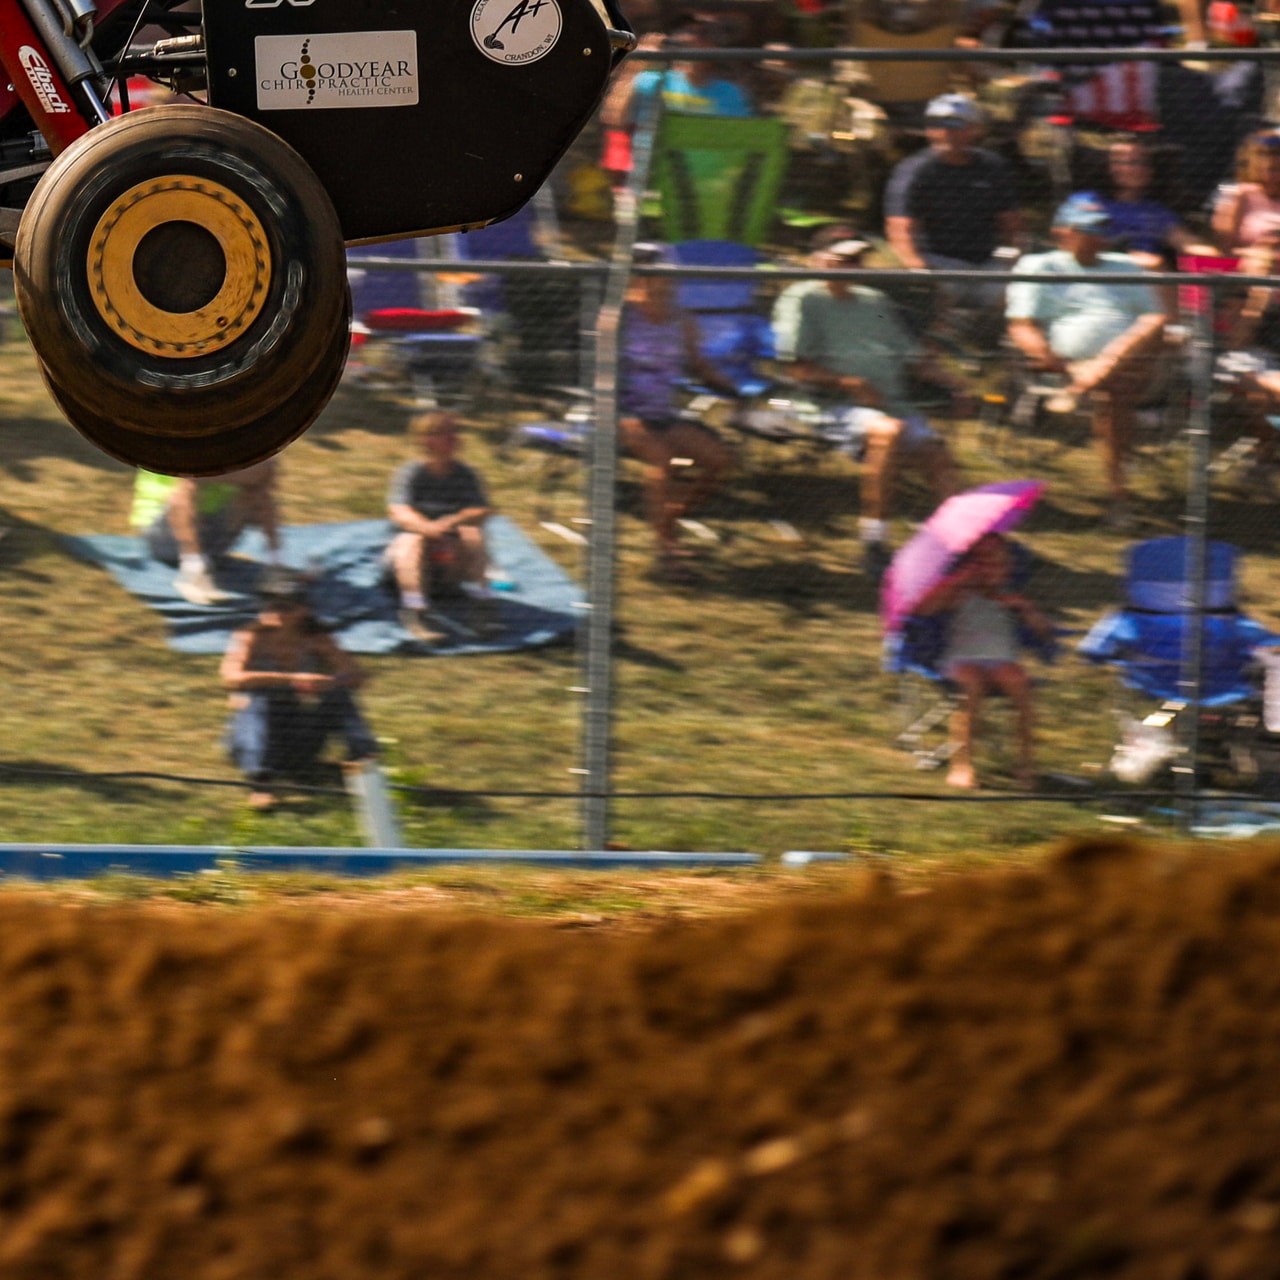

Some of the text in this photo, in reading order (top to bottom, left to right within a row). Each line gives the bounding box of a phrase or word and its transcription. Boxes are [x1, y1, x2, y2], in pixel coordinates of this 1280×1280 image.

[18, 45, 71, 113] Eibach
[338, 86, 414, 96] HEALTH CENTER
